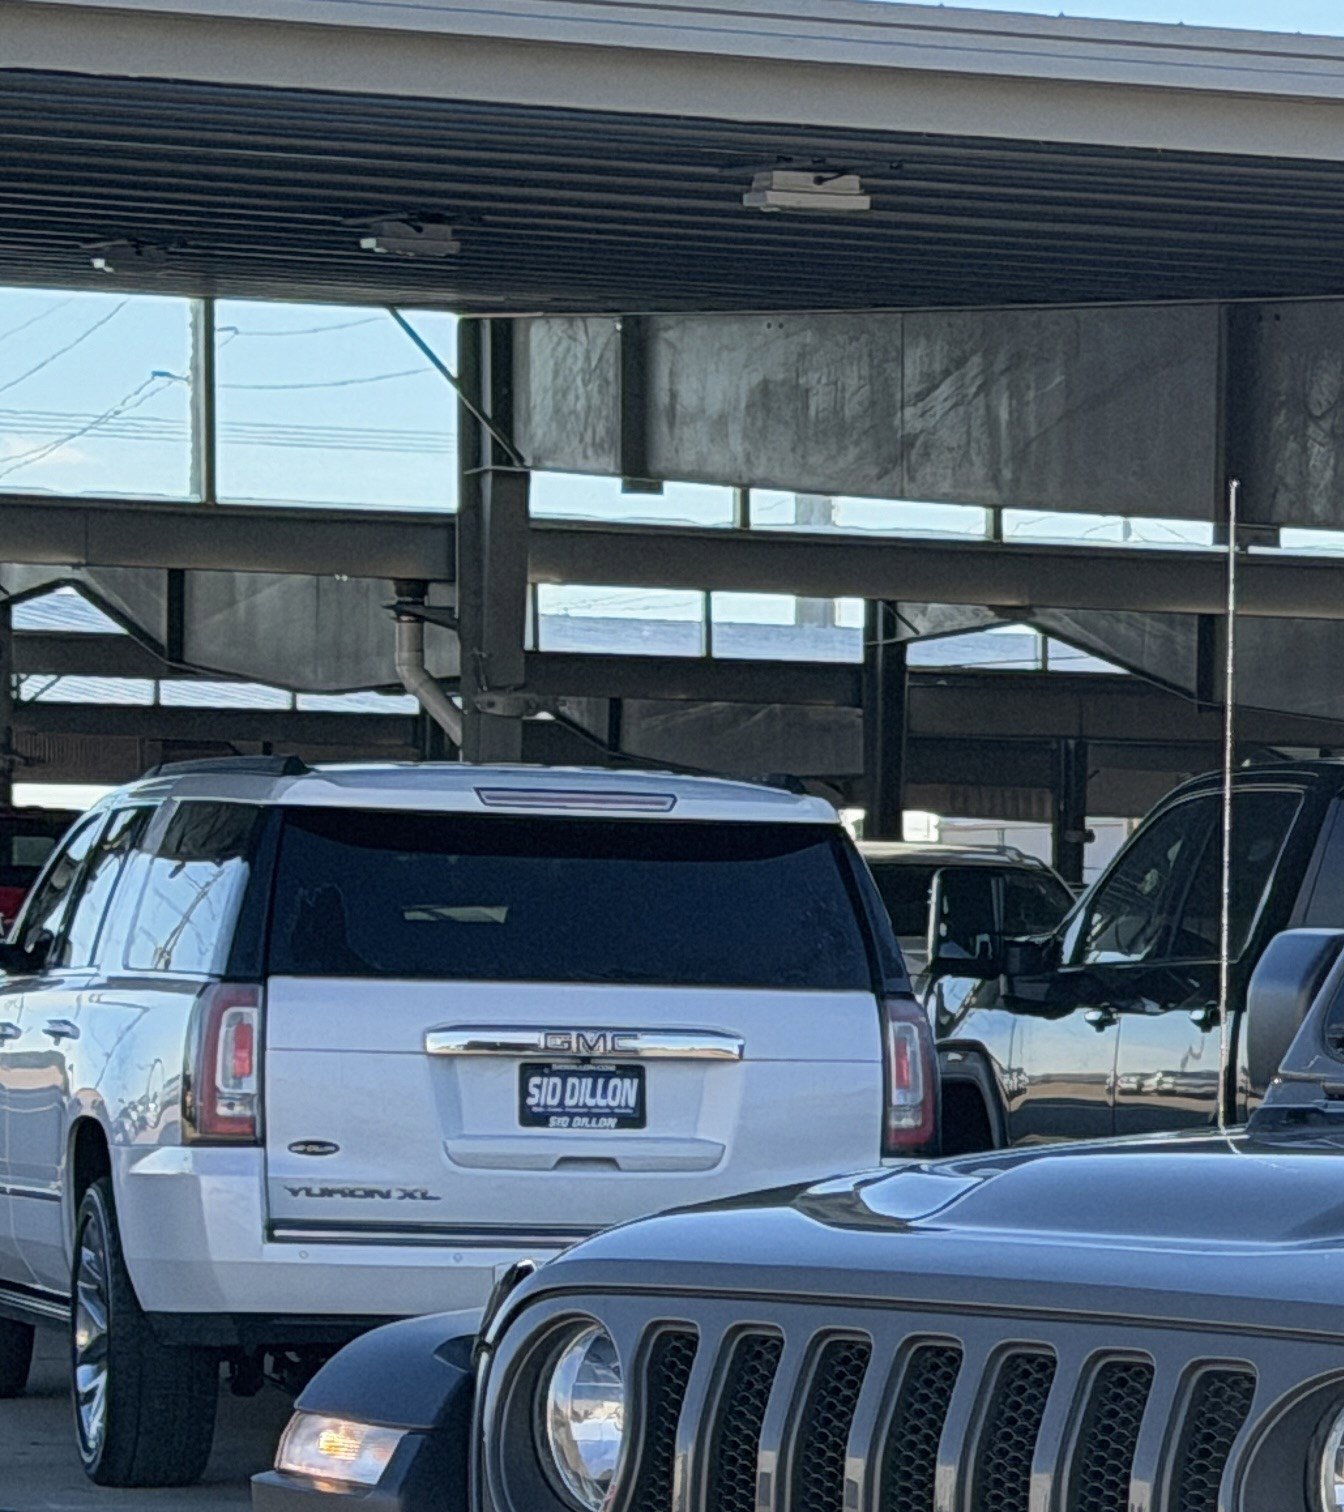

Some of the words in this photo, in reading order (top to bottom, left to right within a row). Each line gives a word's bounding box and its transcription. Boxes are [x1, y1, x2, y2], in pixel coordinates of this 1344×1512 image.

[544, 1032, 640, 1055] GMC
[526, 1076, 563, 1107] SID
[564, 1077, 640, 1108] DILLON
[548, 1116, 569, 1128] SID
[572, 1116, 618, 1129] DILLON
[284, 1185, 391, 1200] YUKON
[395, 1187, 442, 1201] XL
